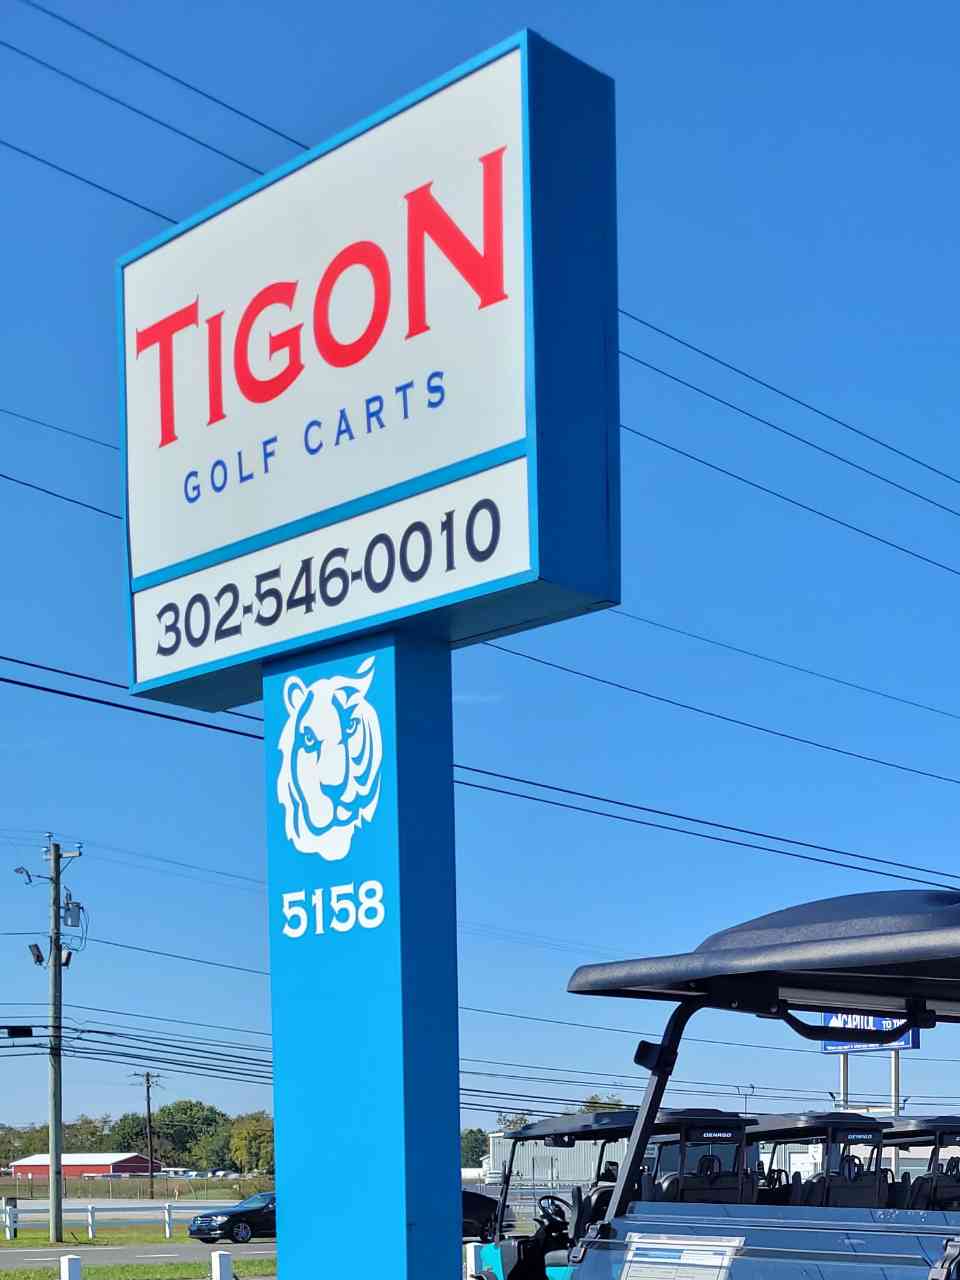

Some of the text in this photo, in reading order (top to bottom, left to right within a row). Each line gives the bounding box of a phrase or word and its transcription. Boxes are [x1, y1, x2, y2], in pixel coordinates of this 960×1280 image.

[136, 145, 509, 448] TIGON
[184, 371, 447, 503] GOLF CARTS
[156, 498, 502, 656] 302-546-0010
[282, 880, 385, 938] 5158
